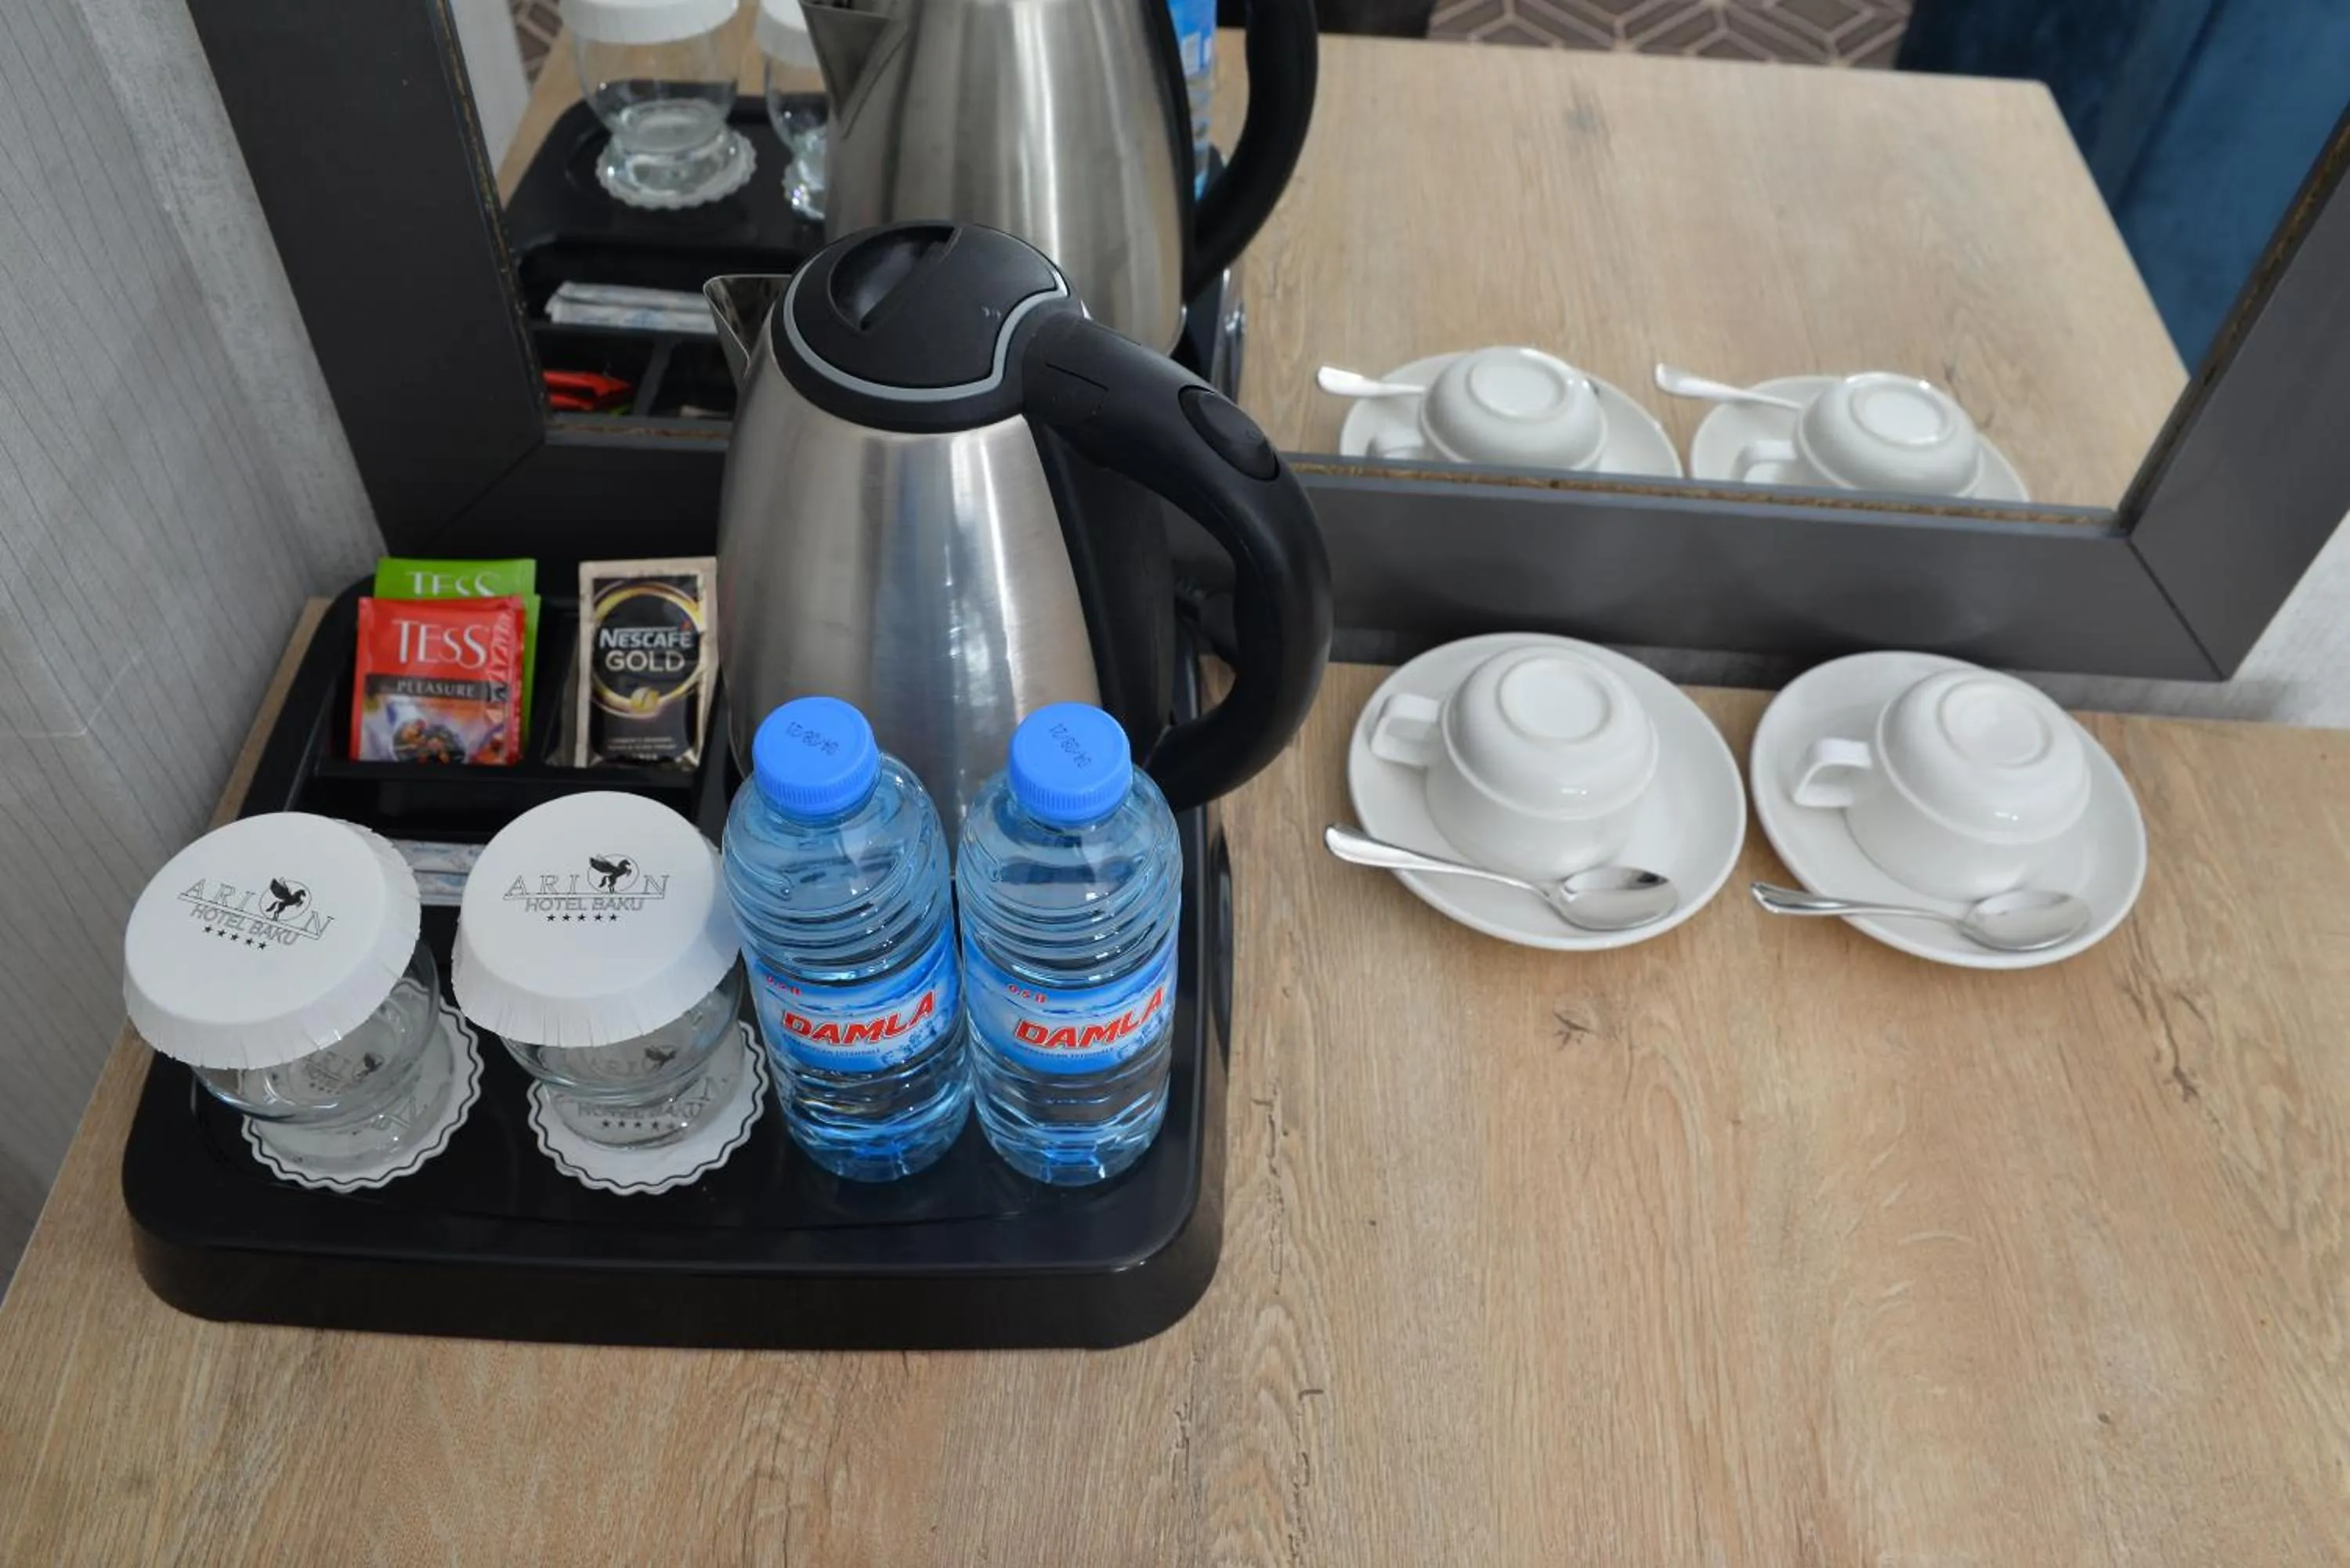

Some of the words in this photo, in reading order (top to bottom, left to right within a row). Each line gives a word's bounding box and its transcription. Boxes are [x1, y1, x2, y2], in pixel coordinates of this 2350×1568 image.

[392, 620, 486, 670] TESS
[605, 650, 685, 672] GOLD
[397, 680, 475, 697] PLEASURE
[190, 903, 245, 931] HOTEL
[249, 920, 299, 946] BAKU
[526, 898, 587, 912] HOTEL
[592, 898, 645, 911] BAKU
[783, 990, 935, 1045] DAMLA
[1015, 987, 1165, 1048] DAMLA
